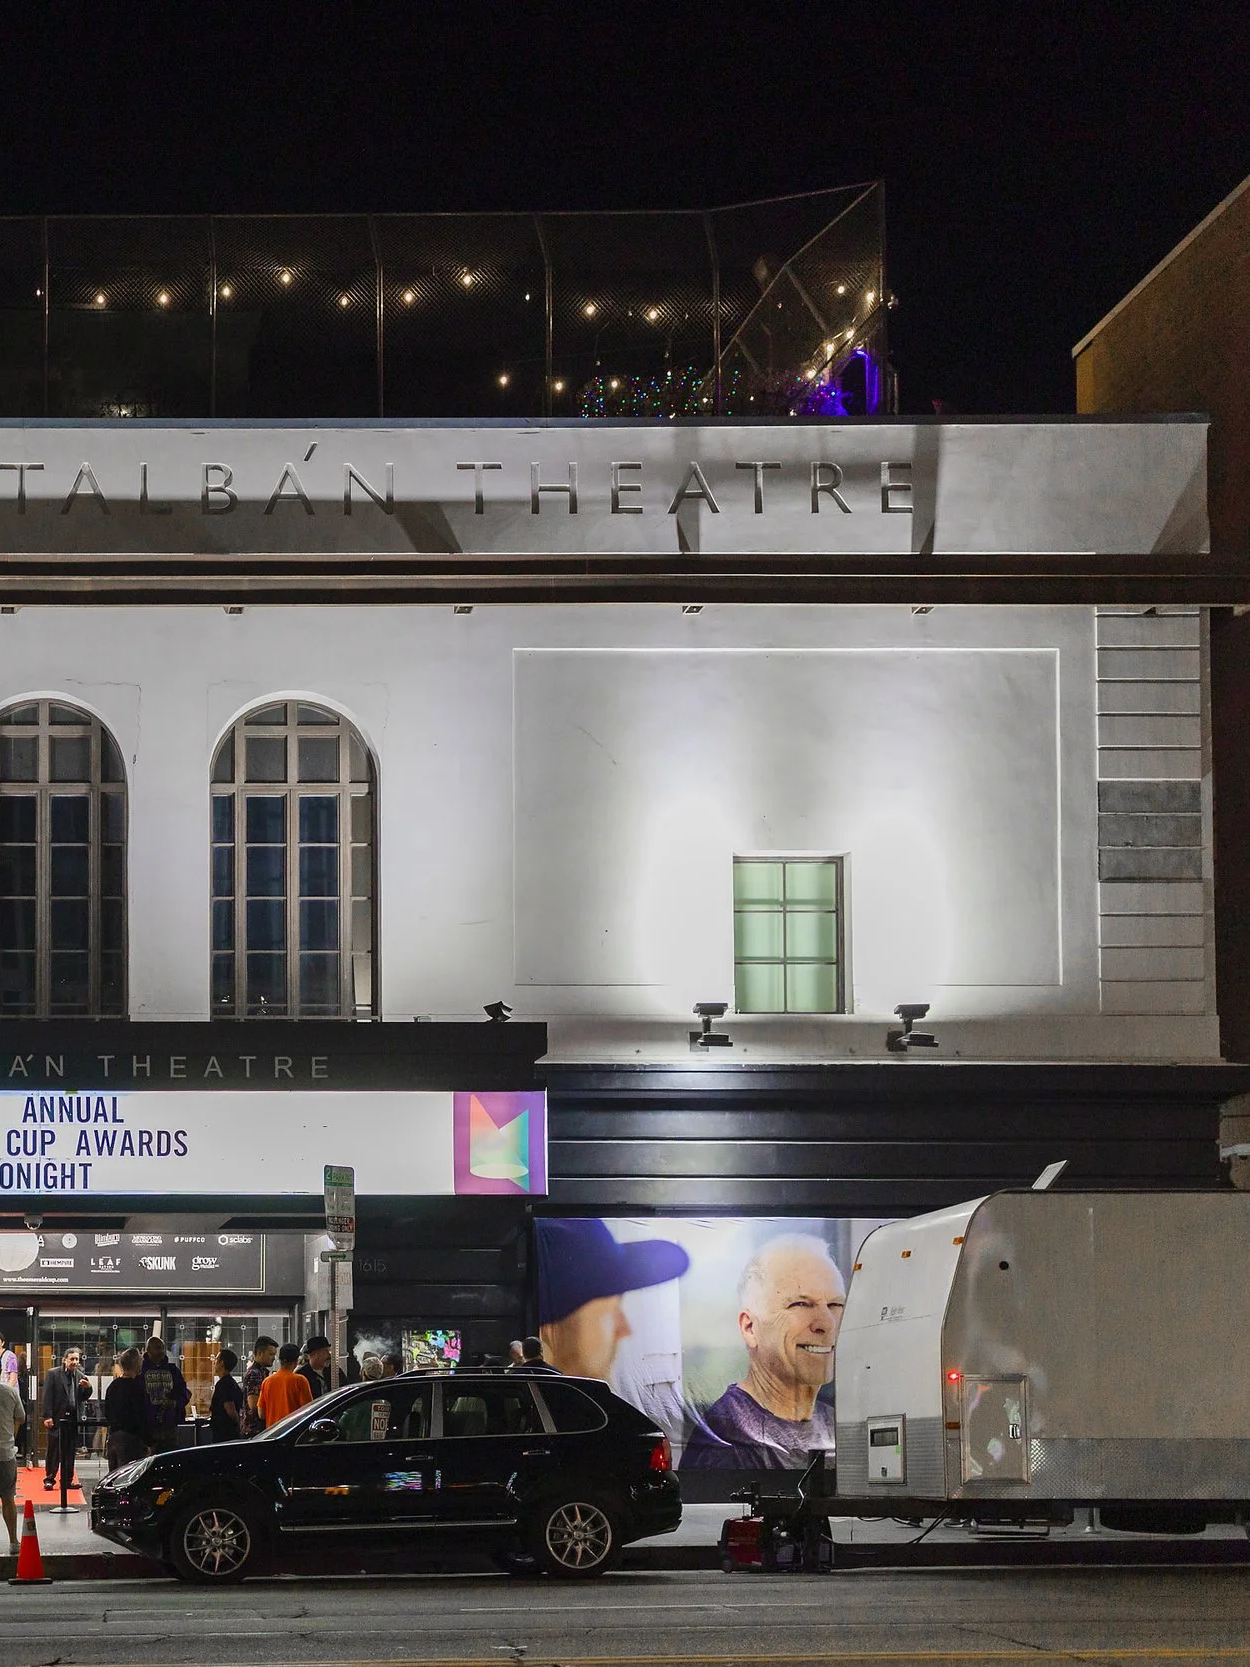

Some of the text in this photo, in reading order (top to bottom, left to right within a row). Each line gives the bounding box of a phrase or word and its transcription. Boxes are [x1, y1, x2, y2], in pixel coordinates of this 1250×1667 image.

[456, 461, 915, 514] THEATRE
[98, 1055, 329, 1079] THEATRE
[22, 1096, 125, 1123] ANNUAL
[6, 1129, 57, 1156] CUP
[75, 1130, 189, 1157] AWARDS
[90, 1257, 121, 1266] LEAF
[146, 1256, 177, 1270] SKUNK
[373, 1418, 386, 1430] NO
